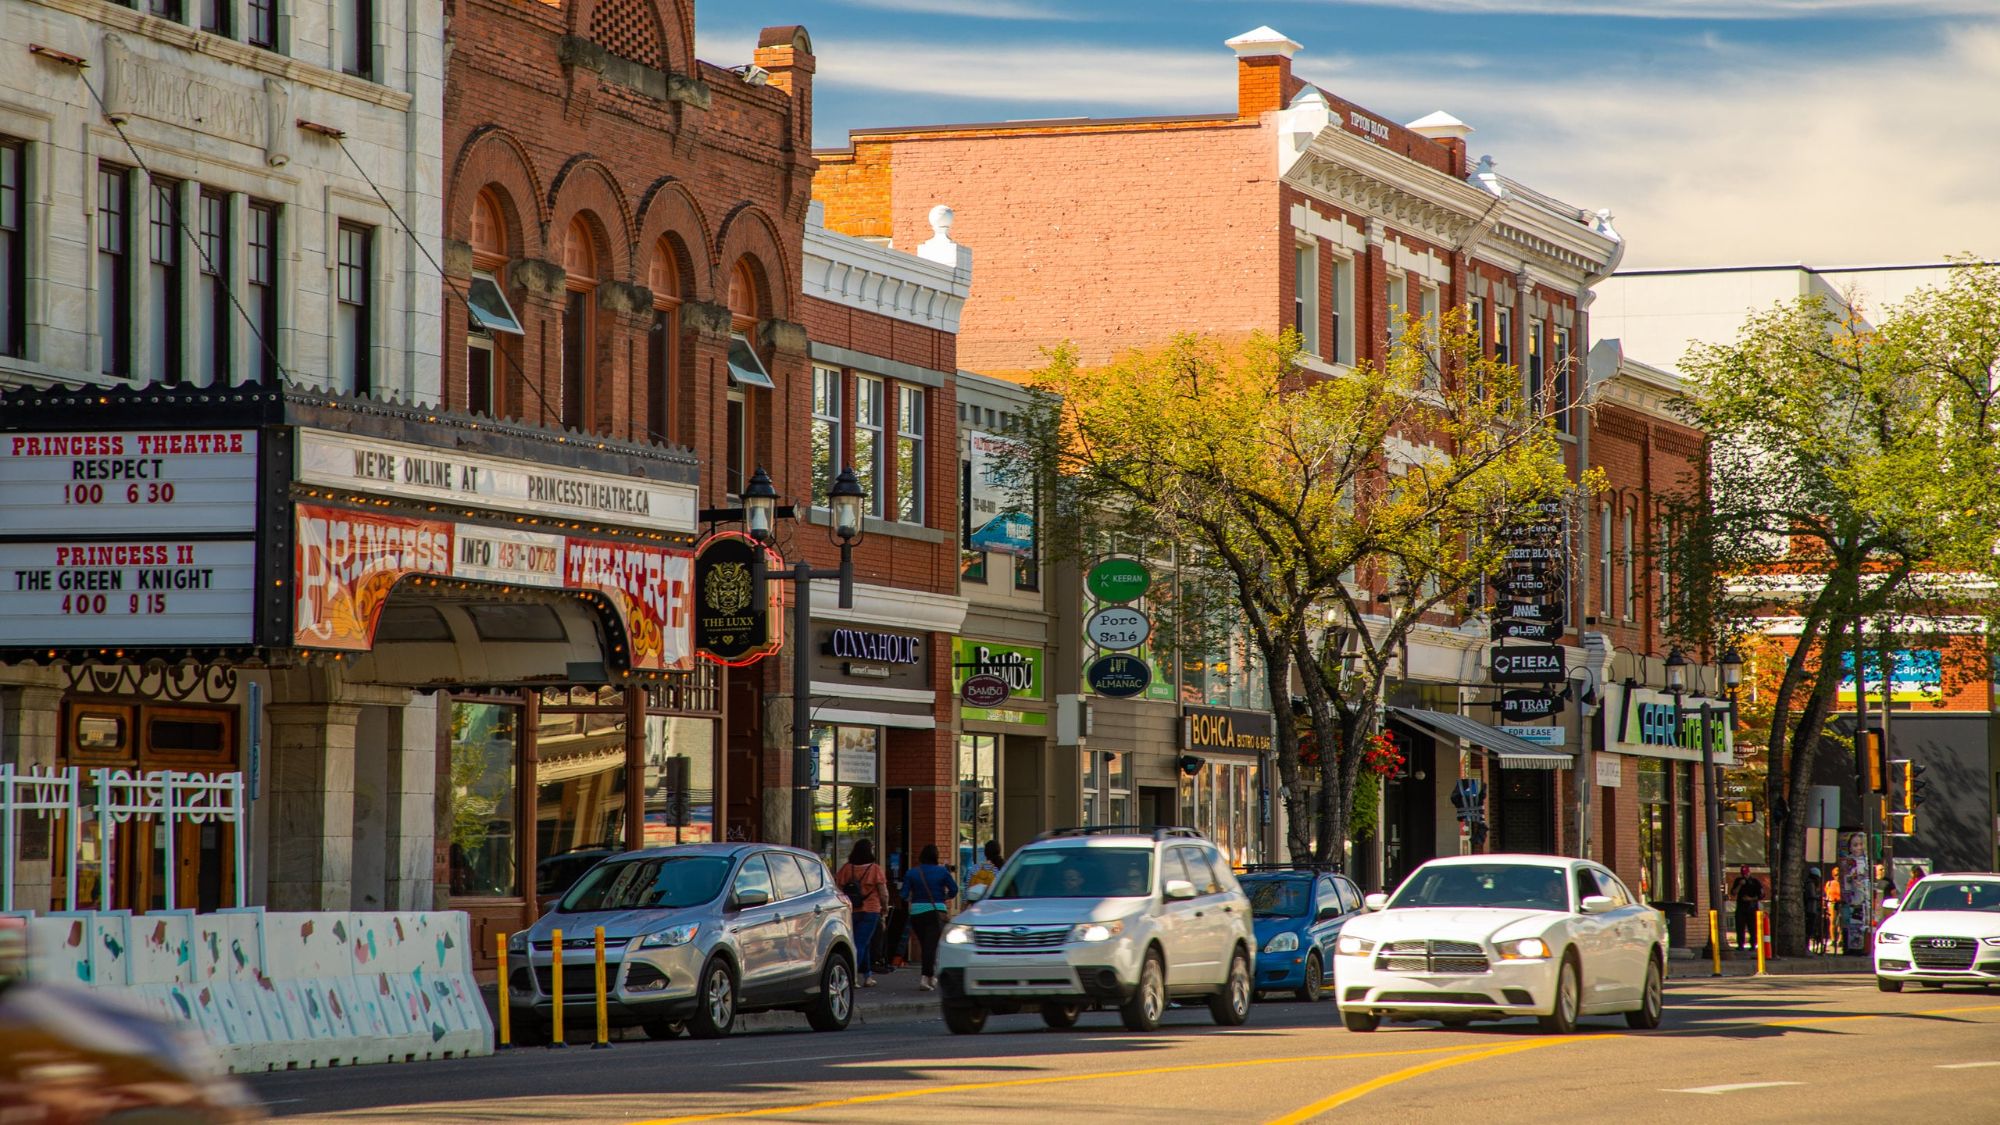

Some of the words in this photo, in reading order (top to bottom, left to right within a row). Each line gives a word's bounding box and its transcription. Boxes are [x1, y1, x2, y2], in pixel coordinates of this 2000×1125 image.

[12, 436, 124, 456] PRINCESS
[138, 434, 243, 453] THEATRE
[72, 459, 163, 479] RESPECT
[354, 450, 395, 481] WE'RE
[404, 457, 451, 487] ONLINE
[462, 465, 478, 491] AT
[528, 475, 650, 514] PRINCESSTHEATRE.CA
[57, 546, 168, 566] PRINCESS
[177, 545, 194, 564] II
[15, 571, 52, 590] THE
[59, 570, 121, 590] GREEN
[139, 569, 213, 589] KNIGHT
[1113, 575, 1142, 583] KEERAN
[297, 518, 449, 641] PRINCESS
[461, 537, 491, 566] INFO
[570, 545, 691, 670] THEATRE
[62, 595, 106, 614] 400
[703, 618, 724, 627] THE
[726, 617, 754, 627] LUXX
[1100, 615, 1139, 626] Porc
[1519, 626, 1546, 634] LBW
[1100, 631, 1138, 643] Salé
[833, 629, 920, 665] CINNAHOLIC
[1511, 656, 1560, 668] FIERA
[1096, 680, 1143, 689] ALMANAC
[1519, 699, 1552, 710] TRAP
[1192, 714, 1235, 747] BOHCA
[1237, 734, 1254, 748] BISTRO
[1508, 728, 1524, 736] FOR
[1526, 728, 1552, 736] LEASE
[1643, 703, 1676, 748] AAR
